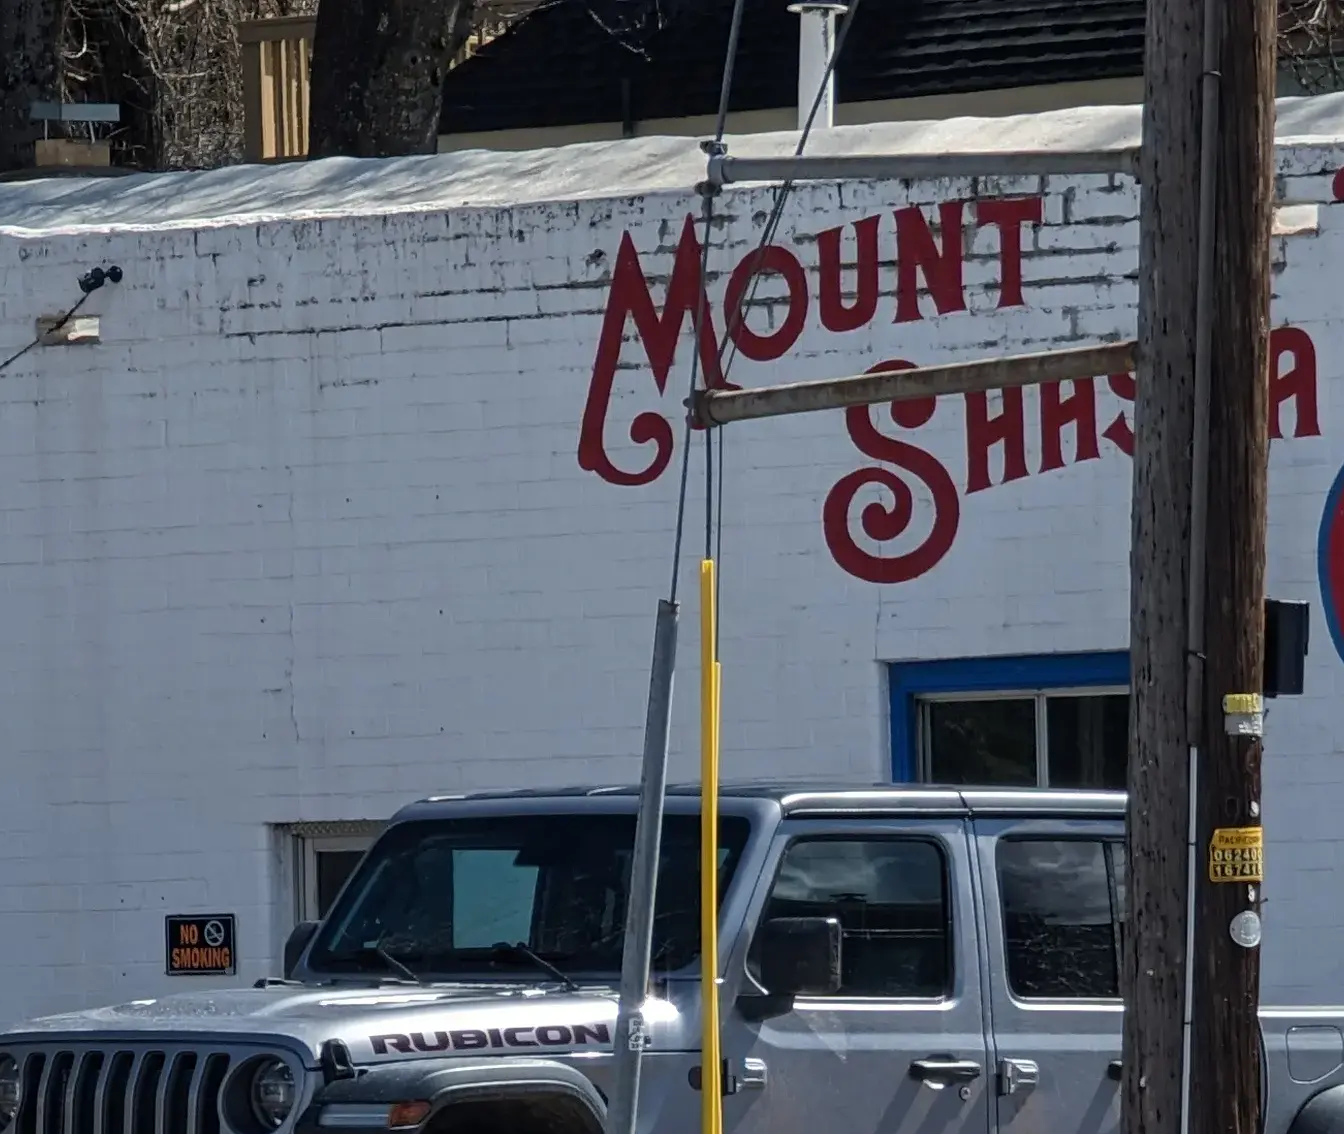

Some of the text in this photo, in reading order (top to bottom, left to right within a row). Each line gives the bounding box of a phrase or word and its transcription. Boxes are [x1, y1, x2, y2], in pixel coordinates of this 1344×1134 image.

[577, 197, 1043, 486] MOUNT
[180, 924, 198, 945] NO
[172, 947, 230, 969] SMOKING
[369, 1024, 611, 1055] RUBICON
